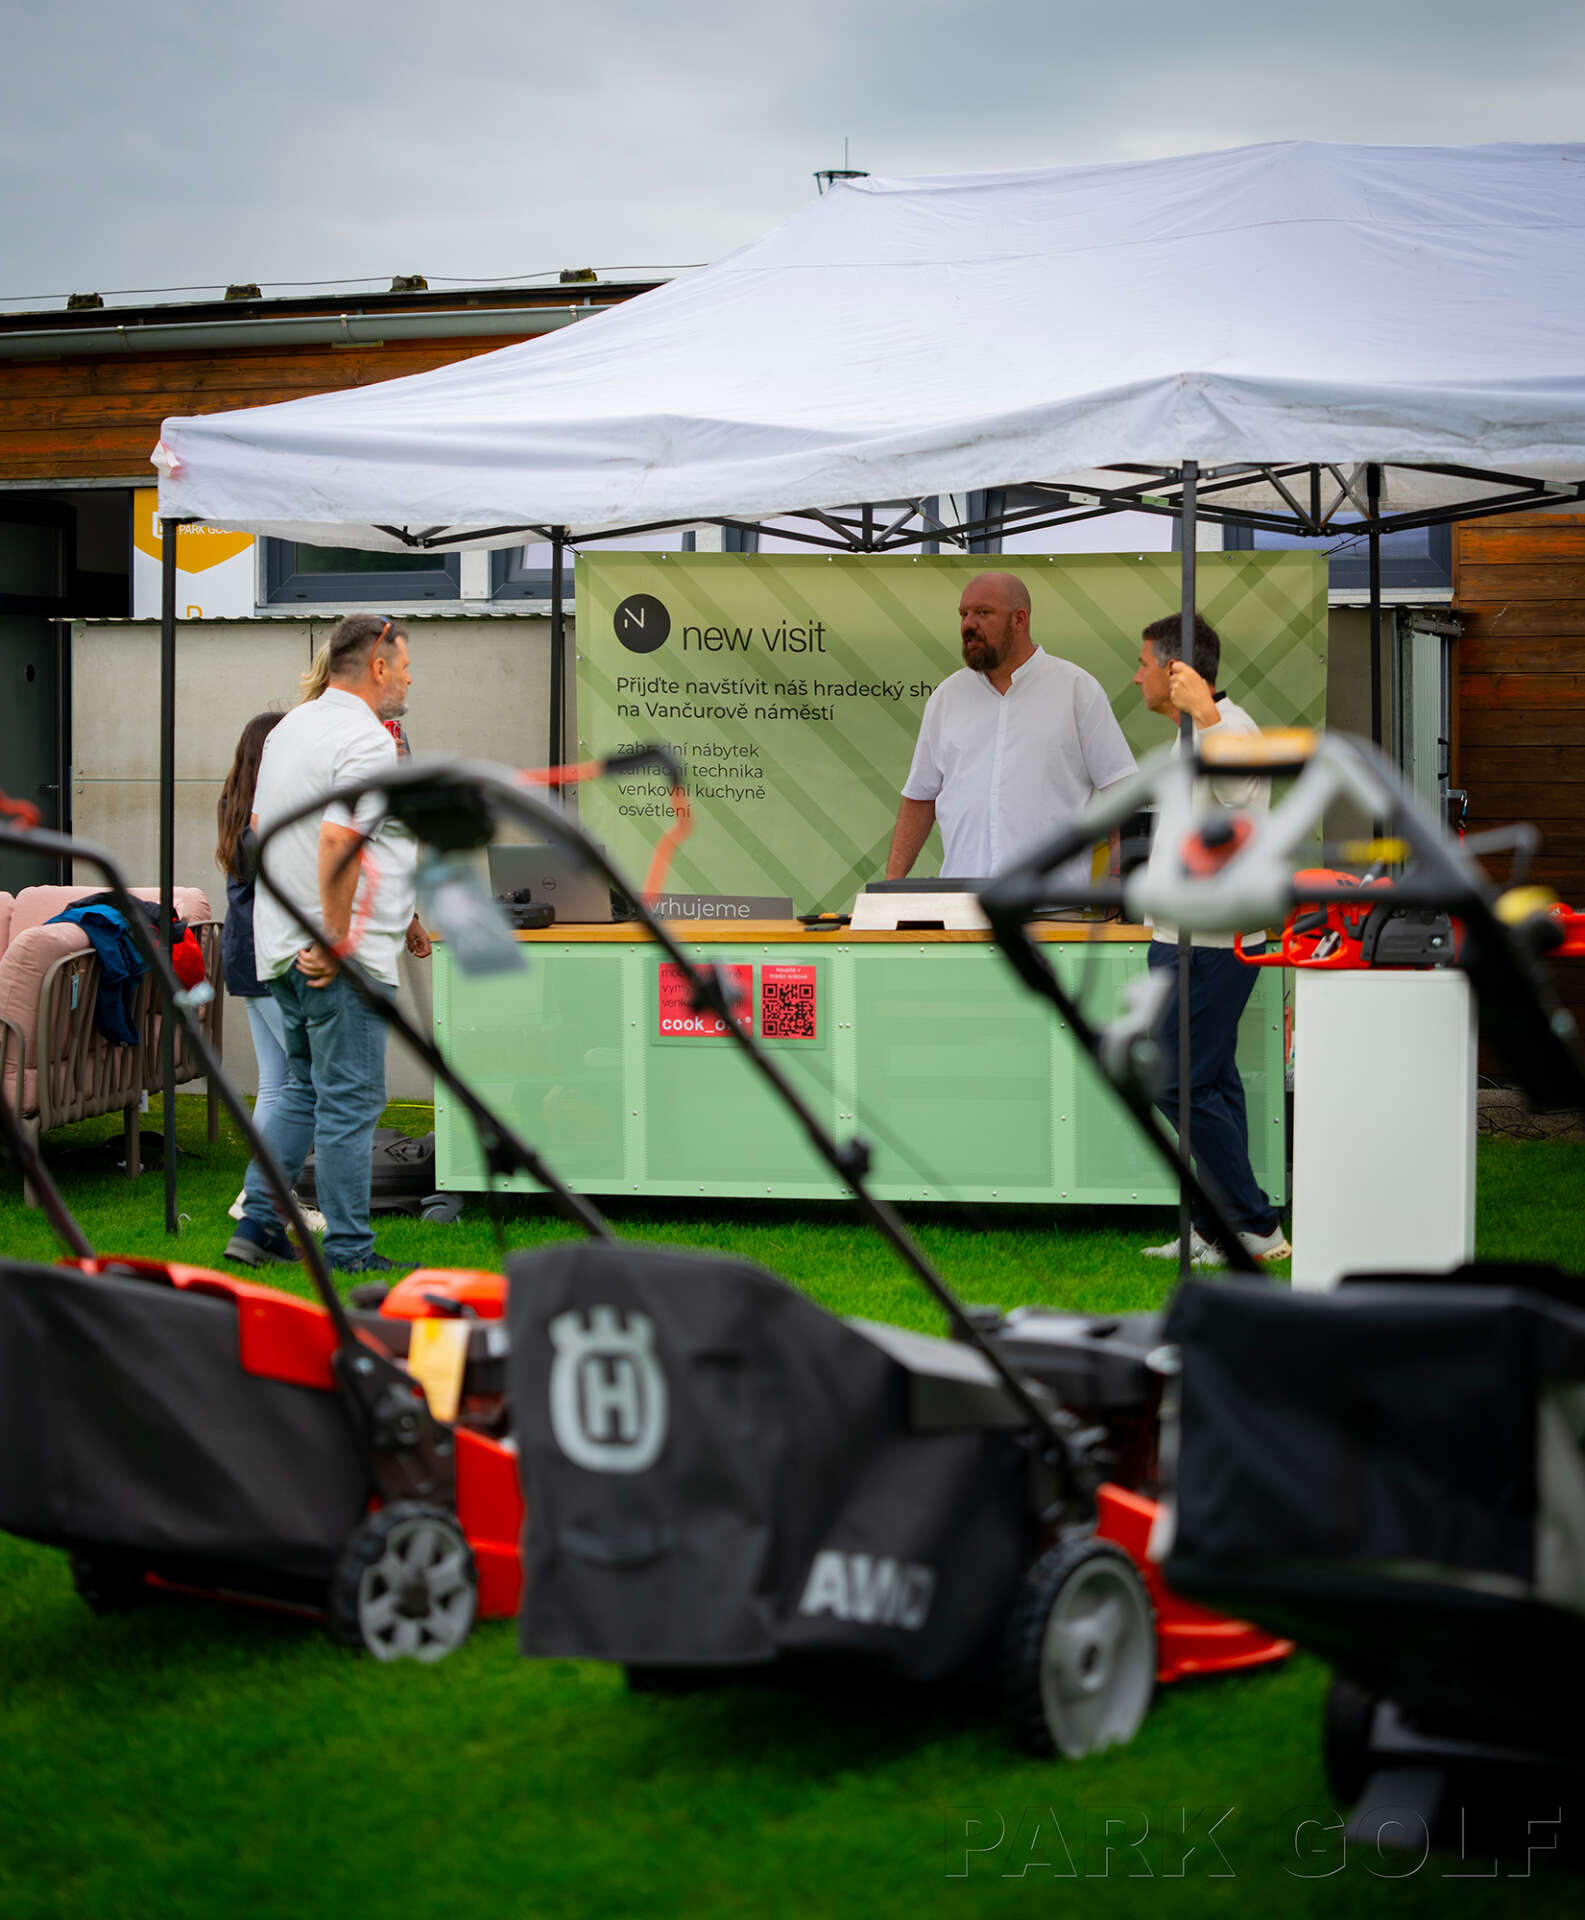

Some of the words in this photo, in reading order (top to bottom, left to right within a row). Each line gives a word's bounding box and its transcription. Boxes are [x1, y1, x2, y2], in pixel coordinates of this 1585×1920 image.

[683, 626, 752, 651] new
[762, 619, 826, 653] visit
[616, 676, 680, 697] Přijďte
[686, 677, 768, 696] navštívit
[775, 679, 808, 696] náš
[814, 680, 904, 701] hradecký
[910, 680, 938, 697] sh
[617, 704, 640, 717] na
[646, 702, 748, 719] Vančurově
[755, 703, 835, 721] náměstí
[692, 742, 760, 760] nábytek
[692, 763, 763, 778] technika
[618, 782, 691, 797] venkovní
[696, 784, 766, 802] kuchyně
[649, 898, 751, 920] vrhujeme
